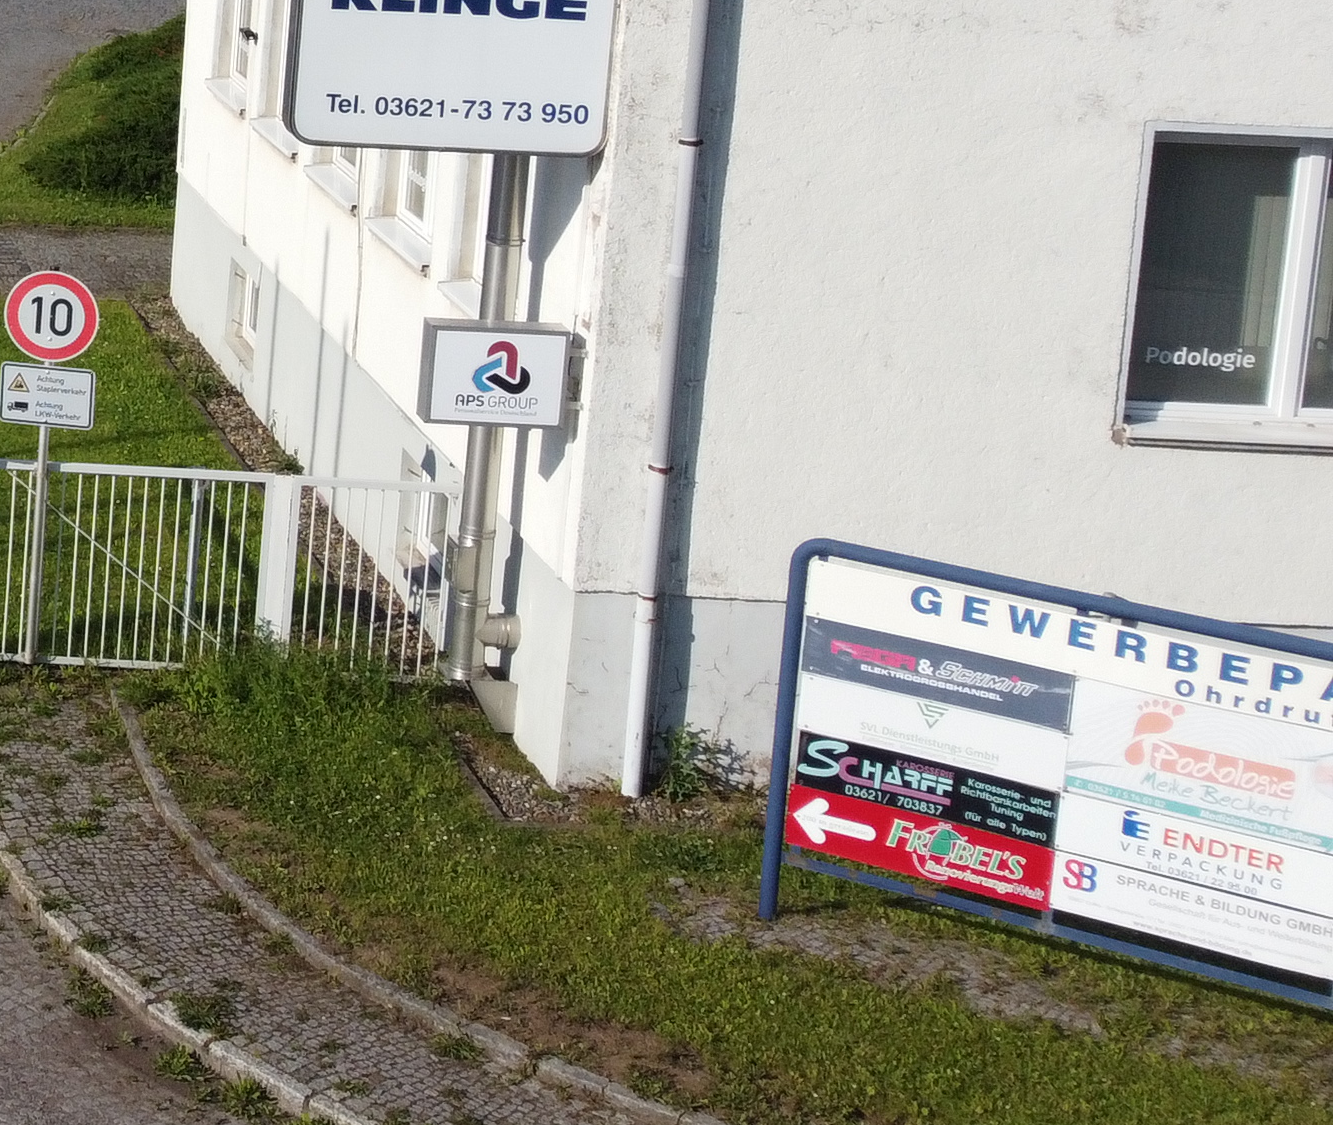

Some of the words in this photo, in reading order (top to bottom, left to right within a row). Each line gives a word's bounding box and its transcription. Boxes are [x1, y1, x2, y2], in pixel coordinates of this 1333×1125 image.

[326, 94, 366, 114] Tel.
[375, 96, 493, 120] 03621-73
[502, 102, 532, 122] 73
[541, 104, 589, 125] 950
[31, 296, 73, 336] 10
[1145, 346, 1256, 372] Podologie
[36, 385, 87, 396] Staplerverkehr
[37, 375, 65, 385] Achtung
[35, 401, 64, 411] Achtung
[35, 411, 82, 421] LKW-Verkehr
[455, 393, 485, 407] APS
[487, 396, 539, 410] GROUP
[918, 659, 934, 677] &
[1175, 679, 1333, 726] Ohrdru
[860, 722, 879, 734] SVL
[882, 726, 963, 756] Dienstleistungs
[965, 746, 1000, 762] GmbH
[797, 740, 954, 801] SCHARFF
[896, 759, 955, 779] KAROSSERIE
[1154, 740, 1295, 798] Podologie
[897, 795, 943, 816] 703837
[960, 786, 1057, 819] Richtbankarbeiten
[967, 778, 1025, 801] Karosserie-
[1030, 795, 1052, 808] und
[1140, 772, 1193, 798] Meike
[1200, 785, 1293, 821] Beckert
[964, 811, 983, 824] (für
[987, 816, 1007, 829] alle
[1010, 822, 1048, 841] Typen)
[990, 803, 1024, 822] Tuning
[1200, 809, 1268, 833] Medizinische
[1269, 825, 1322, 846] Fußpflege
[1120, 841, 1283, 890] VERPACKUNG
[1163, 828, 1284, 874] ENDTER
[1167, 866, 1200, 881] 03621
[1210, 876, 1225, 887] 22
[1244, 885, 1258, 895] 00
[1116, 874, 1191, 902] SPRACHE
[1195, 893, 1206, 906] &
[1210, 898, 1282, 926] BILDUNG
[1286, 918, 1333, 938] GMBH
[1148, 898, 1206, 920] Gesellschaft
[1247, 925, 1266, 936] und
